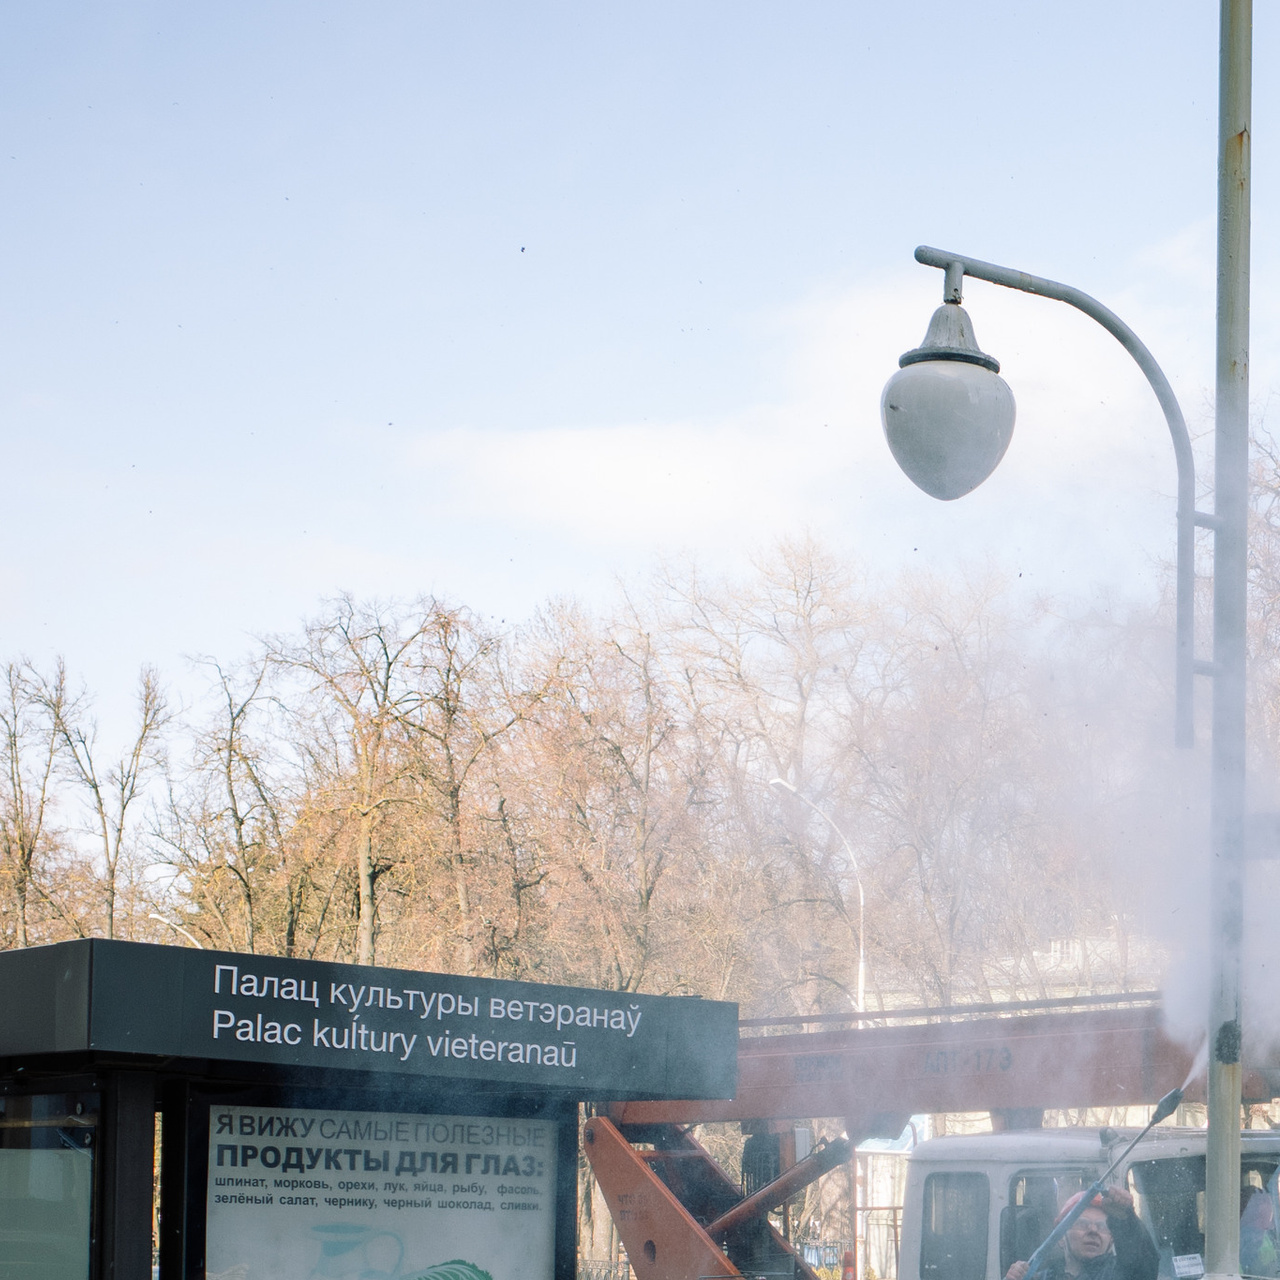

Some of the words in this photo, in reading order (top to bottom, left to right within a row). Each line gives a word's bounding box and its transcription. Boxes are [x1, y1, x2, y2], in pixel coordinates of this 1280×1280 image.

[214, 964, 320, 1008] Палац
[329, 982, 479, 1021] культуры
[489, 997, 642, 1038] ветэранаў
[212, 1009, 302, 1045] Palac
[427, 1029, 577, 1068] vieteranaū
[215, 1114, 234, 1135] Я
[239, 1115, 316, 1138] ВИЖУ
[319, 1118, 410, 1142] САМЫЕ
[414, 1122, 546, 1147] ПОЛЕЗНЫЕ
[216, 1144, 390, 1174] ПРОДУКТЫ
[395, 1151, 459, 1177] ДЛЯ
[465, 1153, 544, 1177] ГЛАЗ:
[214, 1193, 273, 1205] зелёный
[279, 1197, 319, 1207] салат,
[324, 1199, 378, 1210] чернику,
[383, 1197, 432, 1210] черный
[437, 1199, 495, 1211] шоколад,
[215, 1177, 268, 1189] шпинат,
[273, 1178, 333, 1191] морковь,
[337, 1180, 379, 1194] орехи,
[383, 1182, 408, 1194] лук,
[413, 1181, 447, 1193] яйца,
[452, 1183, 487, 1195] рыбу,
